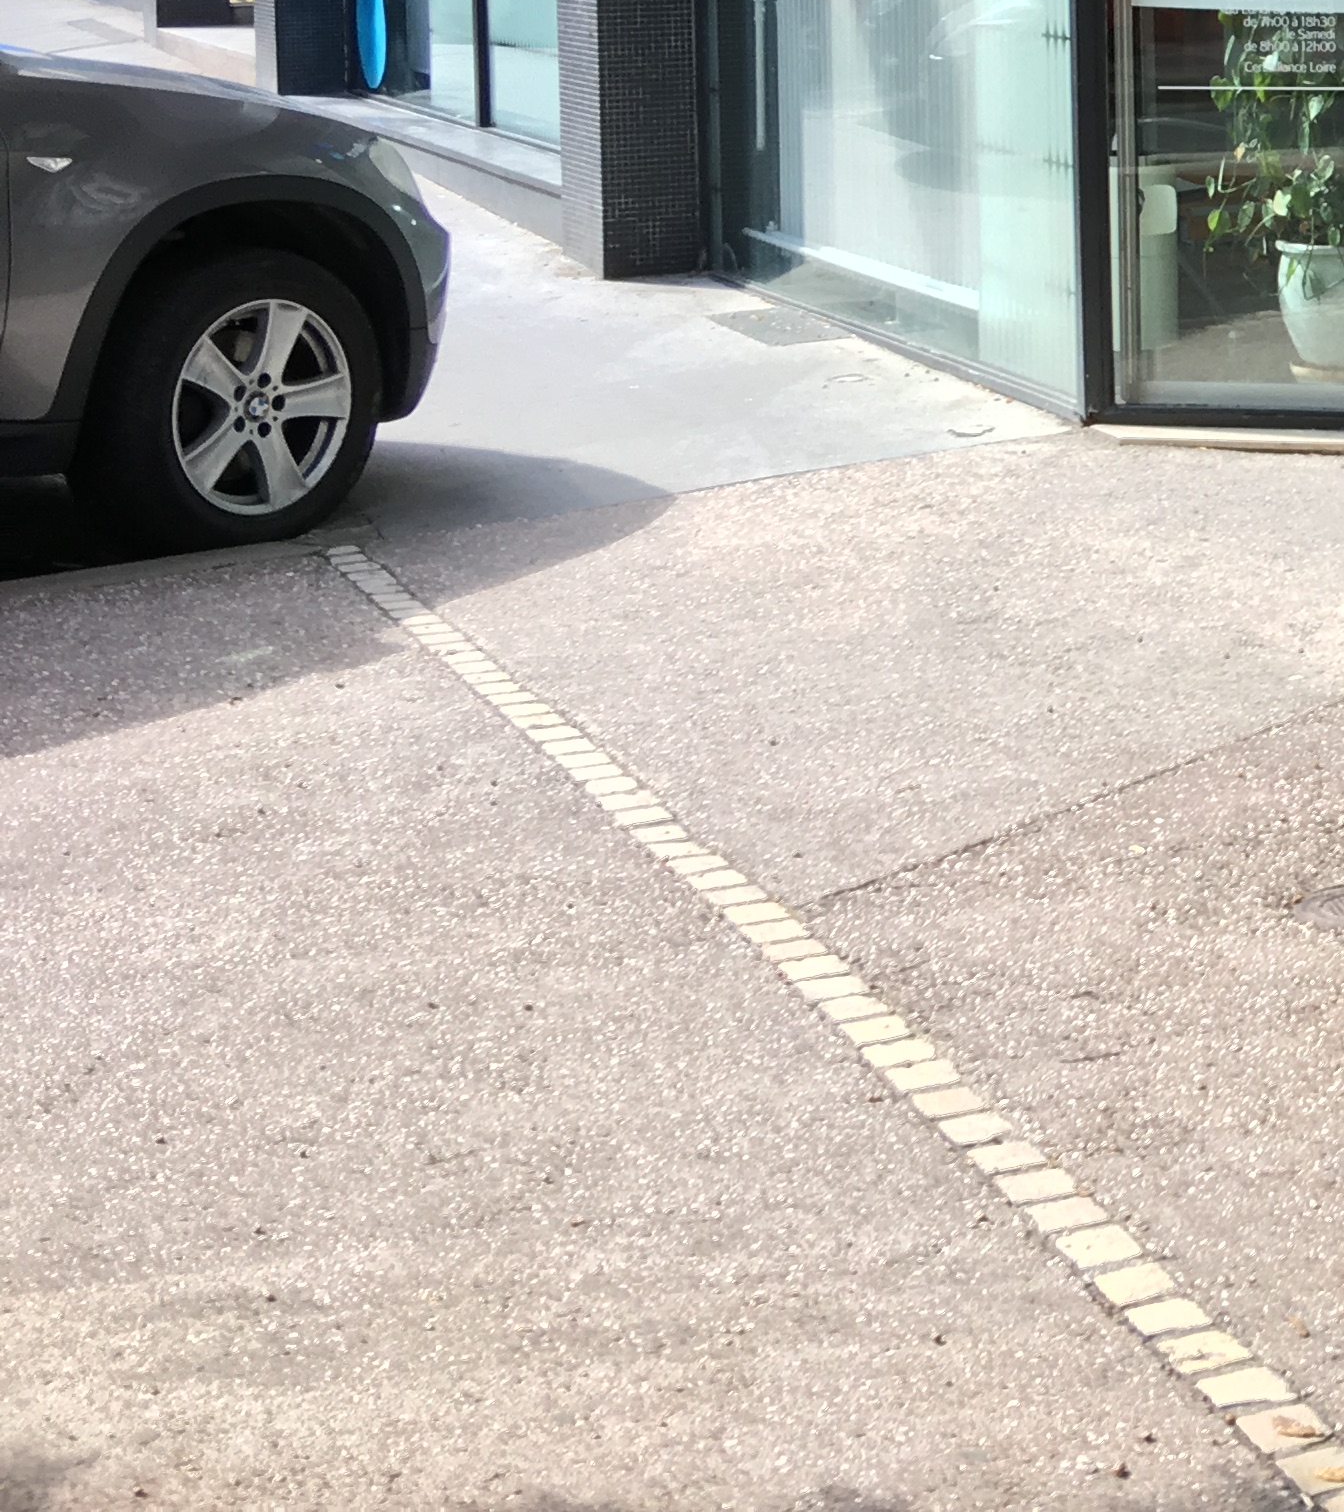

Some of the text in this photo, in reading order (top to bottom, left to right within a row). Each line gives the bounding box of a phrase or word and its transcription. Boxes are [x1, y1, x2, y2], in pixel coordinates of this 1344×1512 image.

[1243, 16, 1256, 27] de
[1291, 16, 1298, 27] à
[1301, 16, 1336, 27] 18h30
[1297, 29, 1335, 39] Samedi
[1244, 41, 1257, 52] de
[1259, 41, 1290, 52] 8h00
[1301, 41, 1336, 52] 12h00
[1309, 61, 1336, 73] Loire
